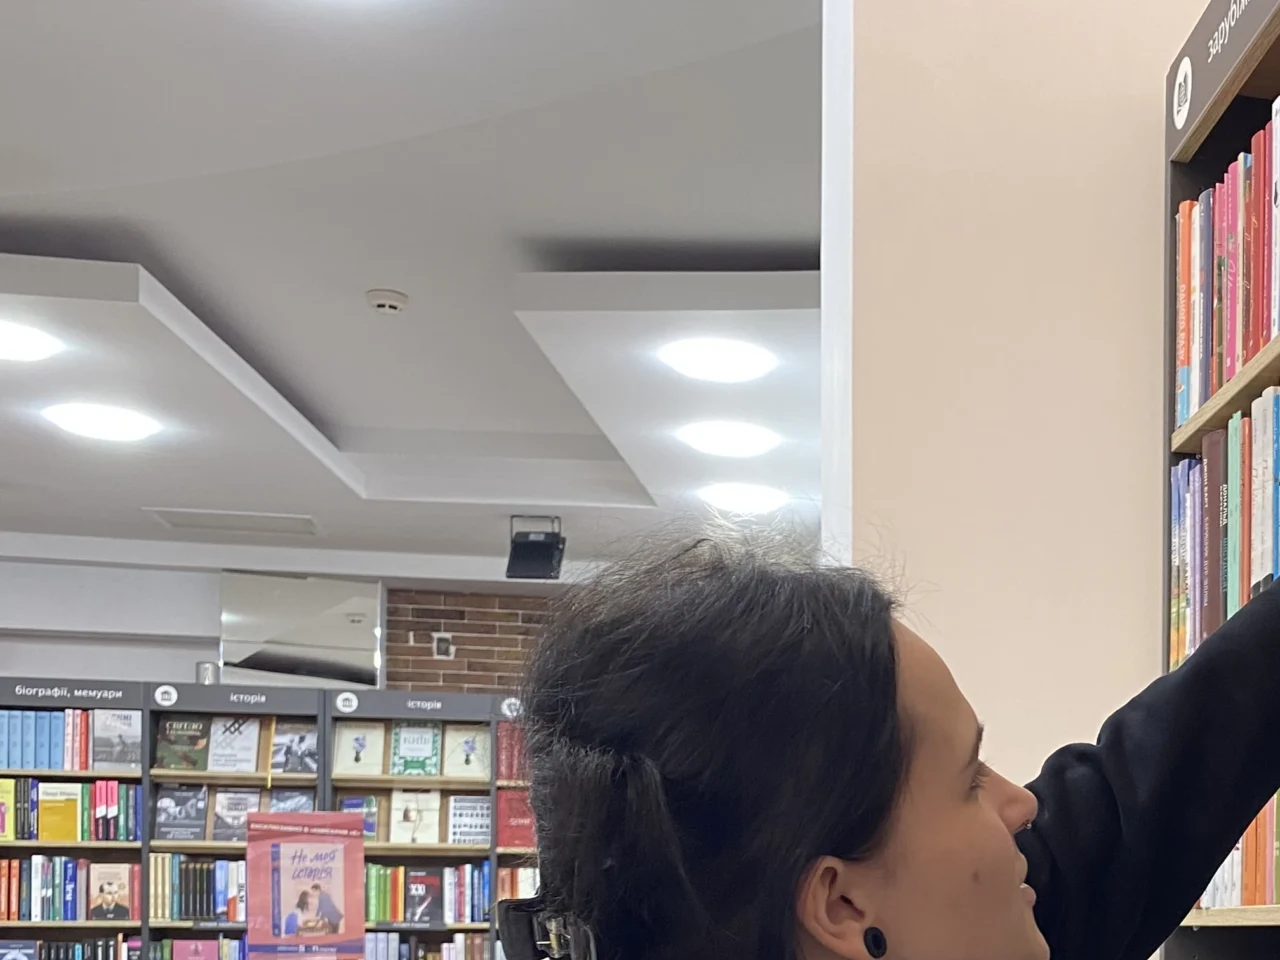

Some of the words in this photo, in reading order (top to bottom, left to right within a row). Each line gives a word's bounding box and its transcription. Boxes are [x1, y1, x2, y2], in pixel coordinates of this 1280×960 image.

[15, 685, 71, 697] біографії,
[74, 688, 122, 699] мемуари
[230, 694, 266, 704] історія
[407, 701, 442, 711] історія
[292, 849, 306, 864] Не
[310, 850, 336, 863] моя
[292, 865, 333, 880] історія
